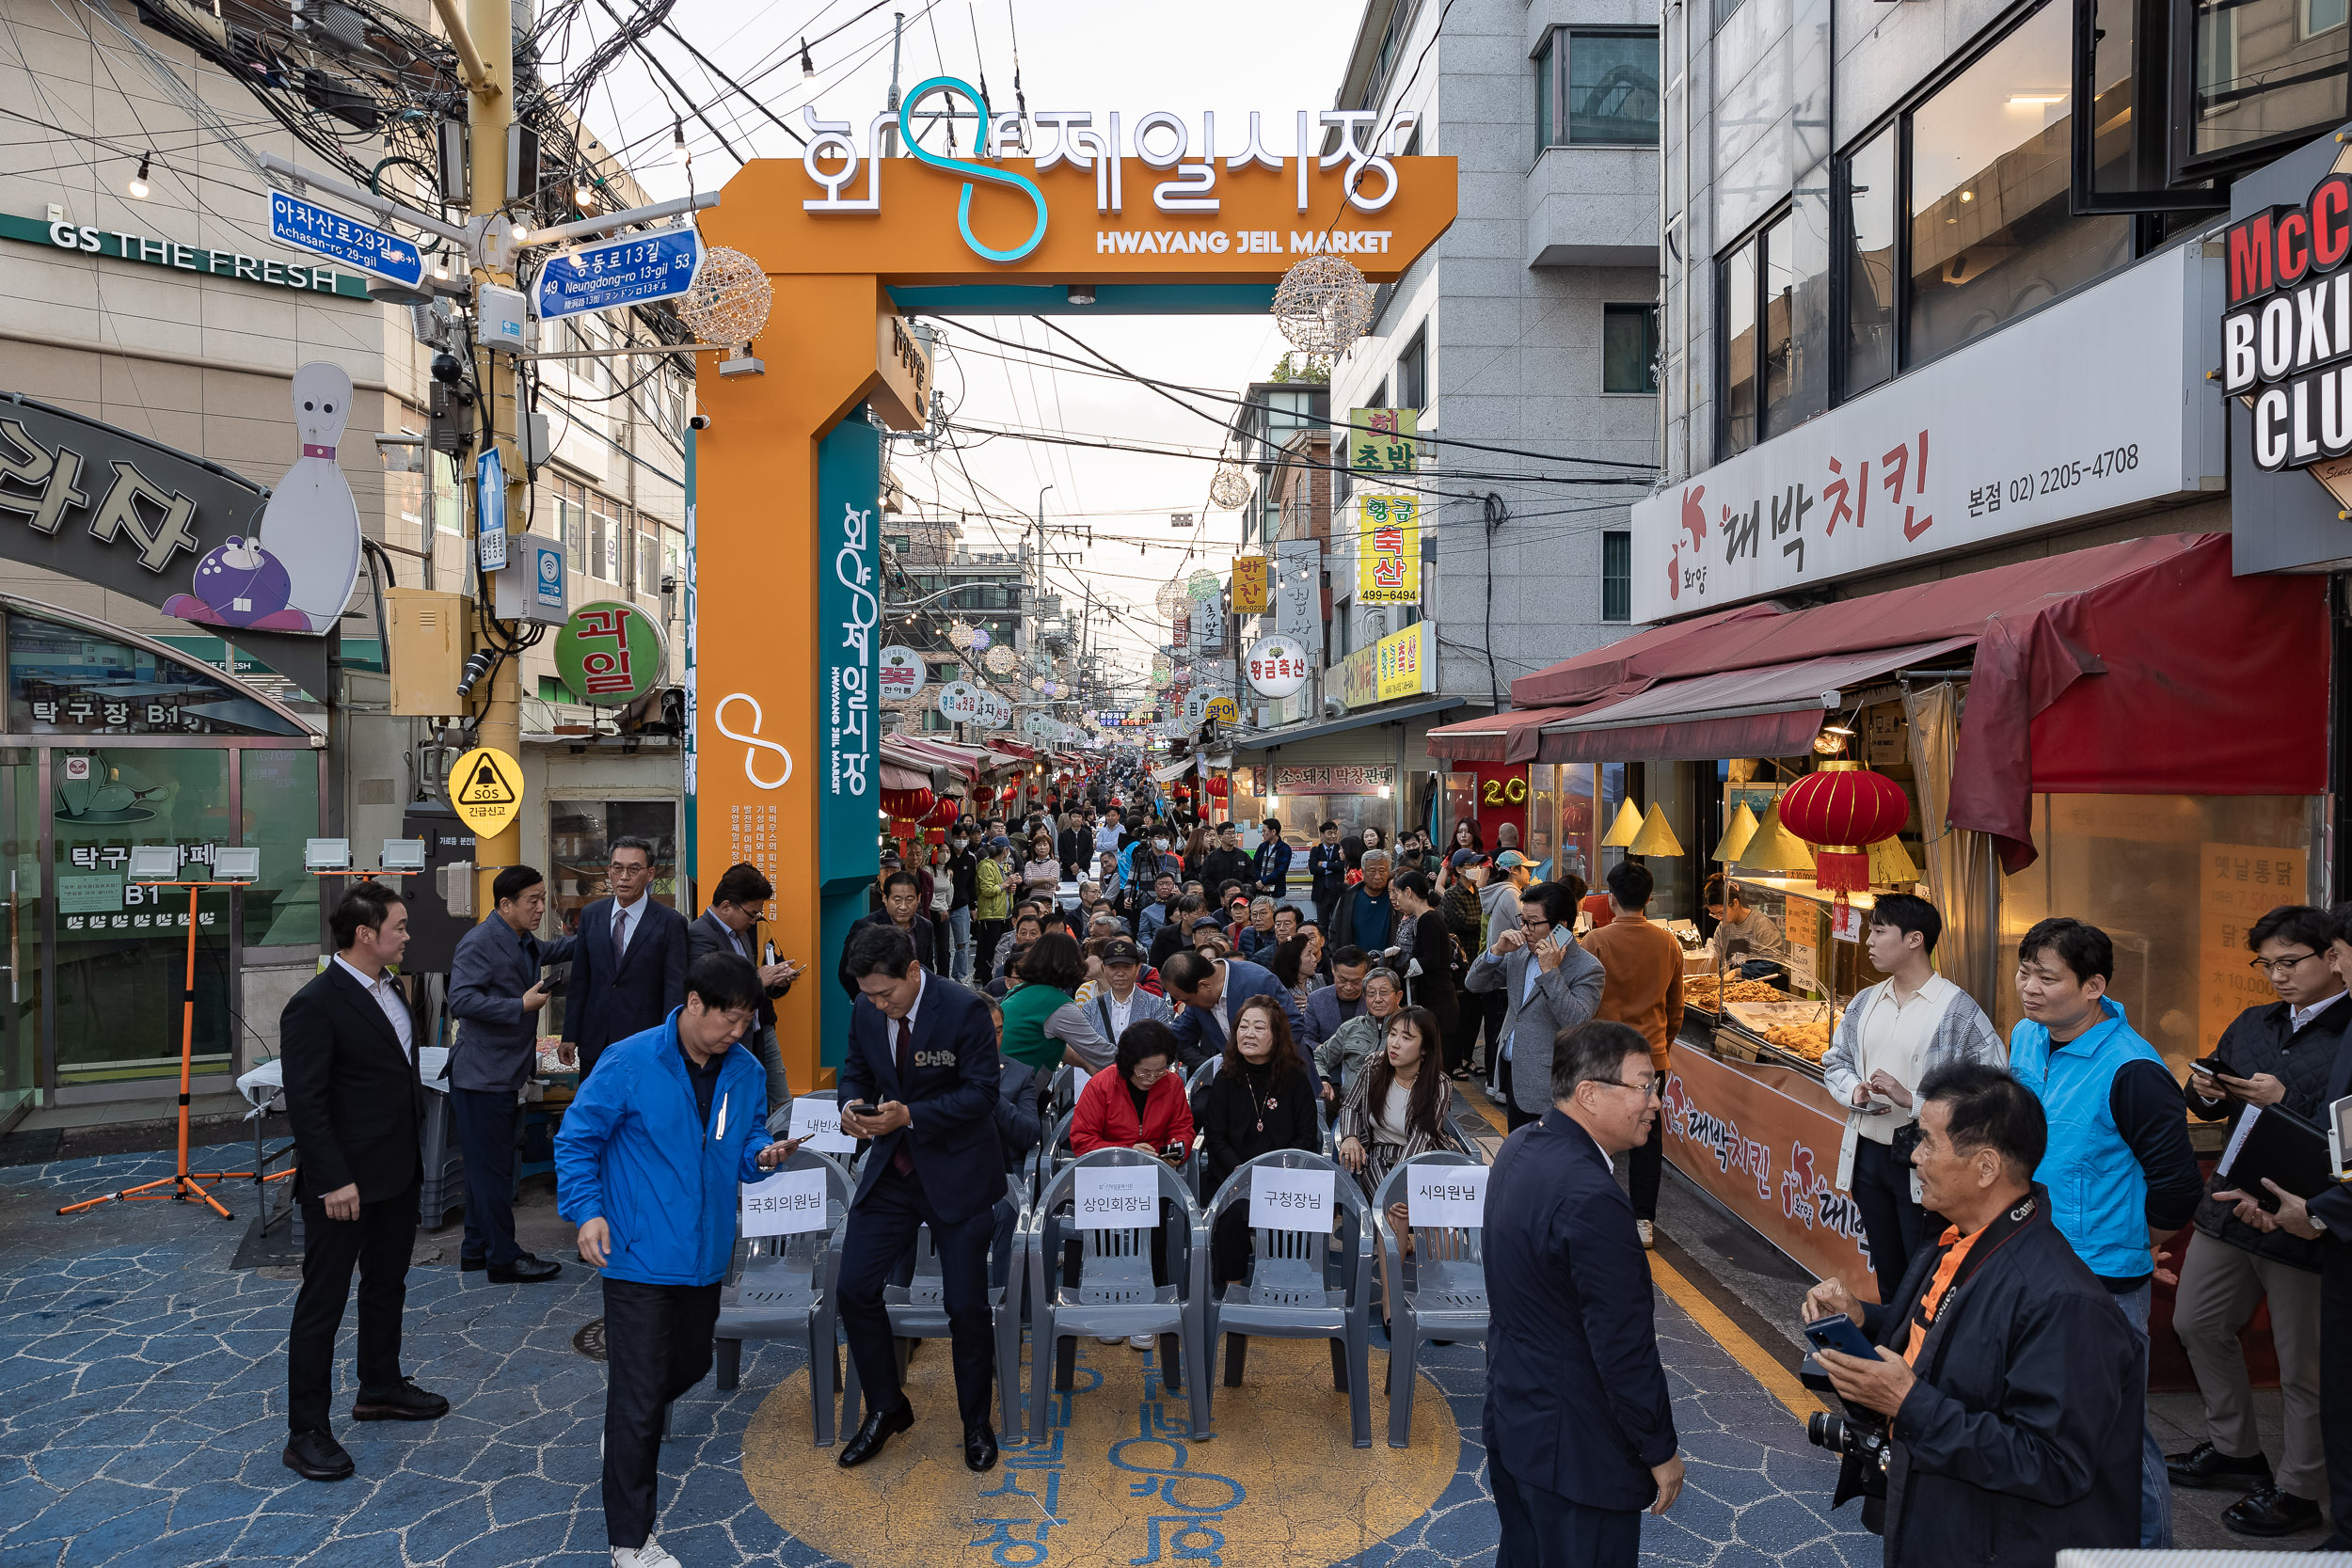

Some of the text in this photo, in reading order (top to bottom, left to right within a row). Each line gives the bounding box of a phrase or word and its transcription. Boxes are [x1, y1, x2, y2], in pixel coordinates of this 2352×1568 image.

[275, 199, 391, 261] 아차산로29길
[1096, 230, 1392, 255] HWAYANG JEIL MARKET
[49, 221, 337, 293] GS THE FRESH
[278, 222, 377, 268] Achasan-ro 29-gil
[675, 253, 691, 270] 53
[544, 279, 558, 295] 49
[565, 262, 668, 294] Neungdong-ro 13-gil
[1367, 410, 1398, 445] 회
[1354, 443, 1415, 470] 초밥
[1367, 498, 1415, 523] 황금
[1684, 565, 1708, 594] 화양
[1967, 481, 2001, 518] 본점
[2010, 477, 2035, 503] 02)
[2040, 443, 2139, 494] 2205-4708
[1373, 525, 1406, 589] 축산
[1240, 561, 1261, 604] 반찬
[1362, 590, 1416, 601] 499-6494
[577, 610, 635, 695] 과일
[880, 667, 916, 685] 꽃
[1250, 659, 1305, 681] 황금축산
[148, 705, 179, 724] B1
[1207, 704, 1235, 719] 광어
[832, 667, 840, 795] HWAYANG JEIL MARKET
[474, 788, 500, 800] SOS
[469, 806, 506, 817] 긴급신고
[769, 805, 777, 851] 뫼비우스의
[125, 885, 159, 905] B1
[748, 1191, 821, 1214] 국회의원님
[1083, 1196, 1151, 1212] 상인회장님
[1263, 1190, 1322, 1210] 구청장님
[1420, 1183, 1476, 1201] 시의원님
[1793, 1195, 1814, 1230] 화양
[1934, 1286, 1957, 1323] Canon
